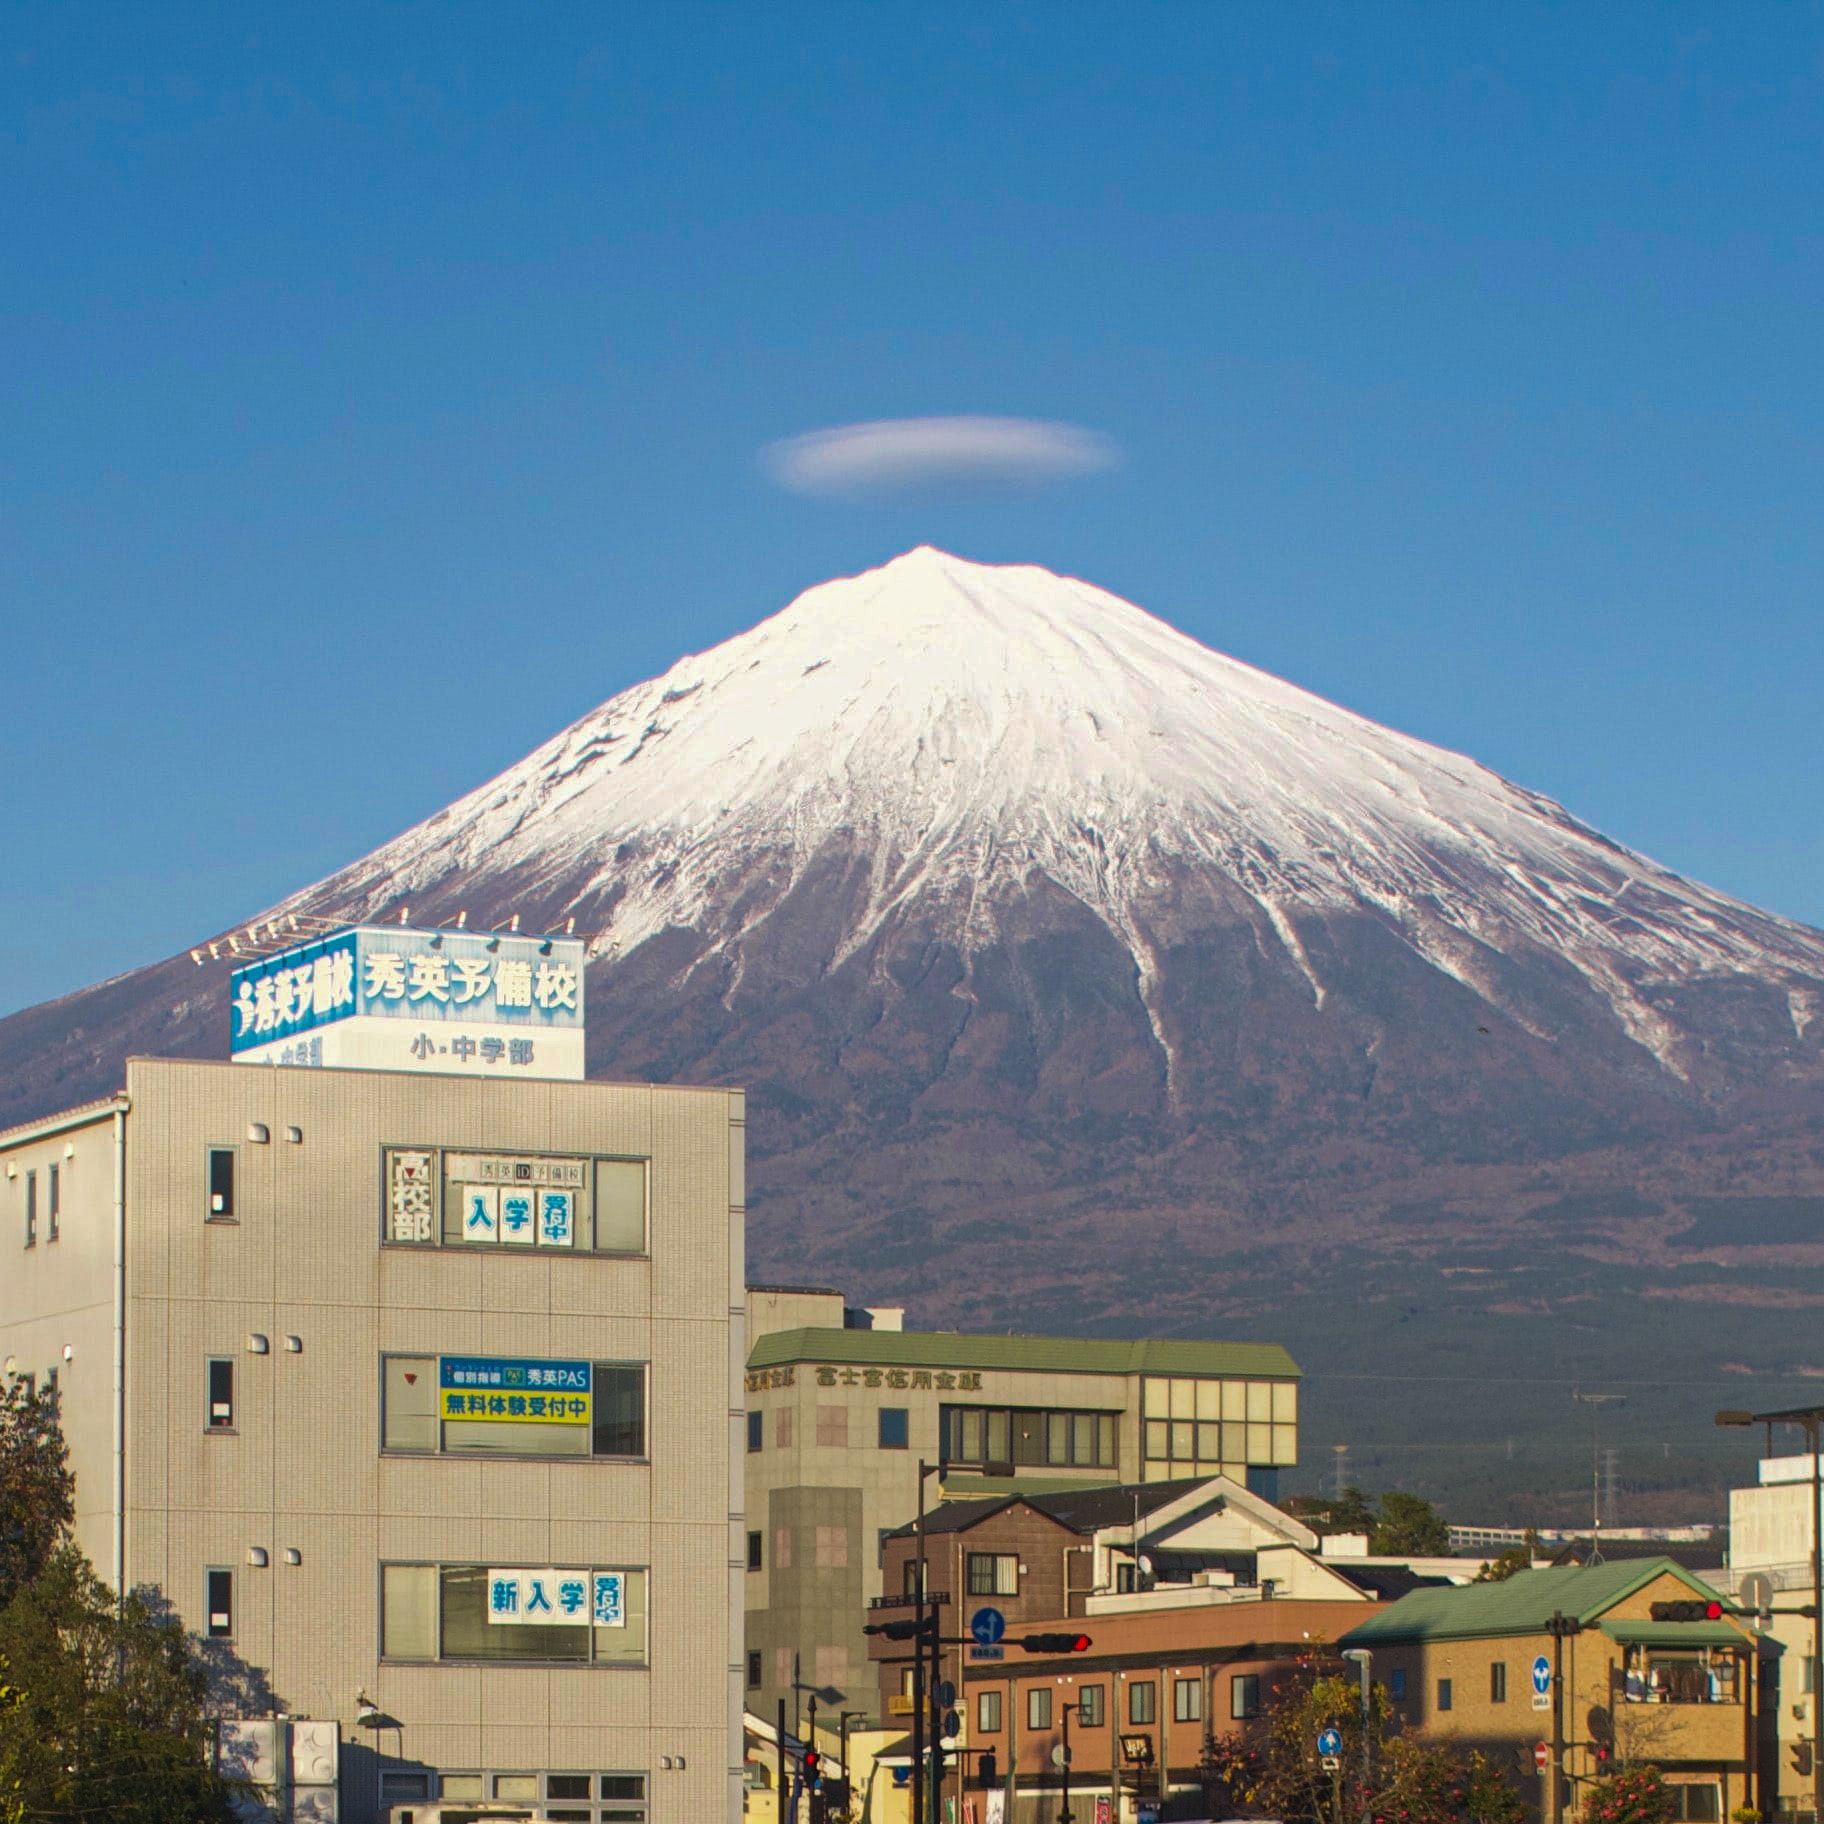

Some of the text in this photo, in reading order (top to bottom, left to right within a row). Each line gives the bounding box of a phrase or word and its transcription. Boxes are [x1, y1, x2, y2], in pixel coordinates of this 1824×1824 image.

[255, 949, 354, 1034] 秀英予備校
[364, 951, 578, 1010] 秀英予備校
[410, 1032, 535, 1066] 小・中学部
[393, 1153, 432, 1241] 高校部
[527, 1369, 586, 1387] 秀英PAS
[815, 1366, 983, 1391] 富士宮信用金庫
[446, 1394, 586, 1418] 無料体験受付中
